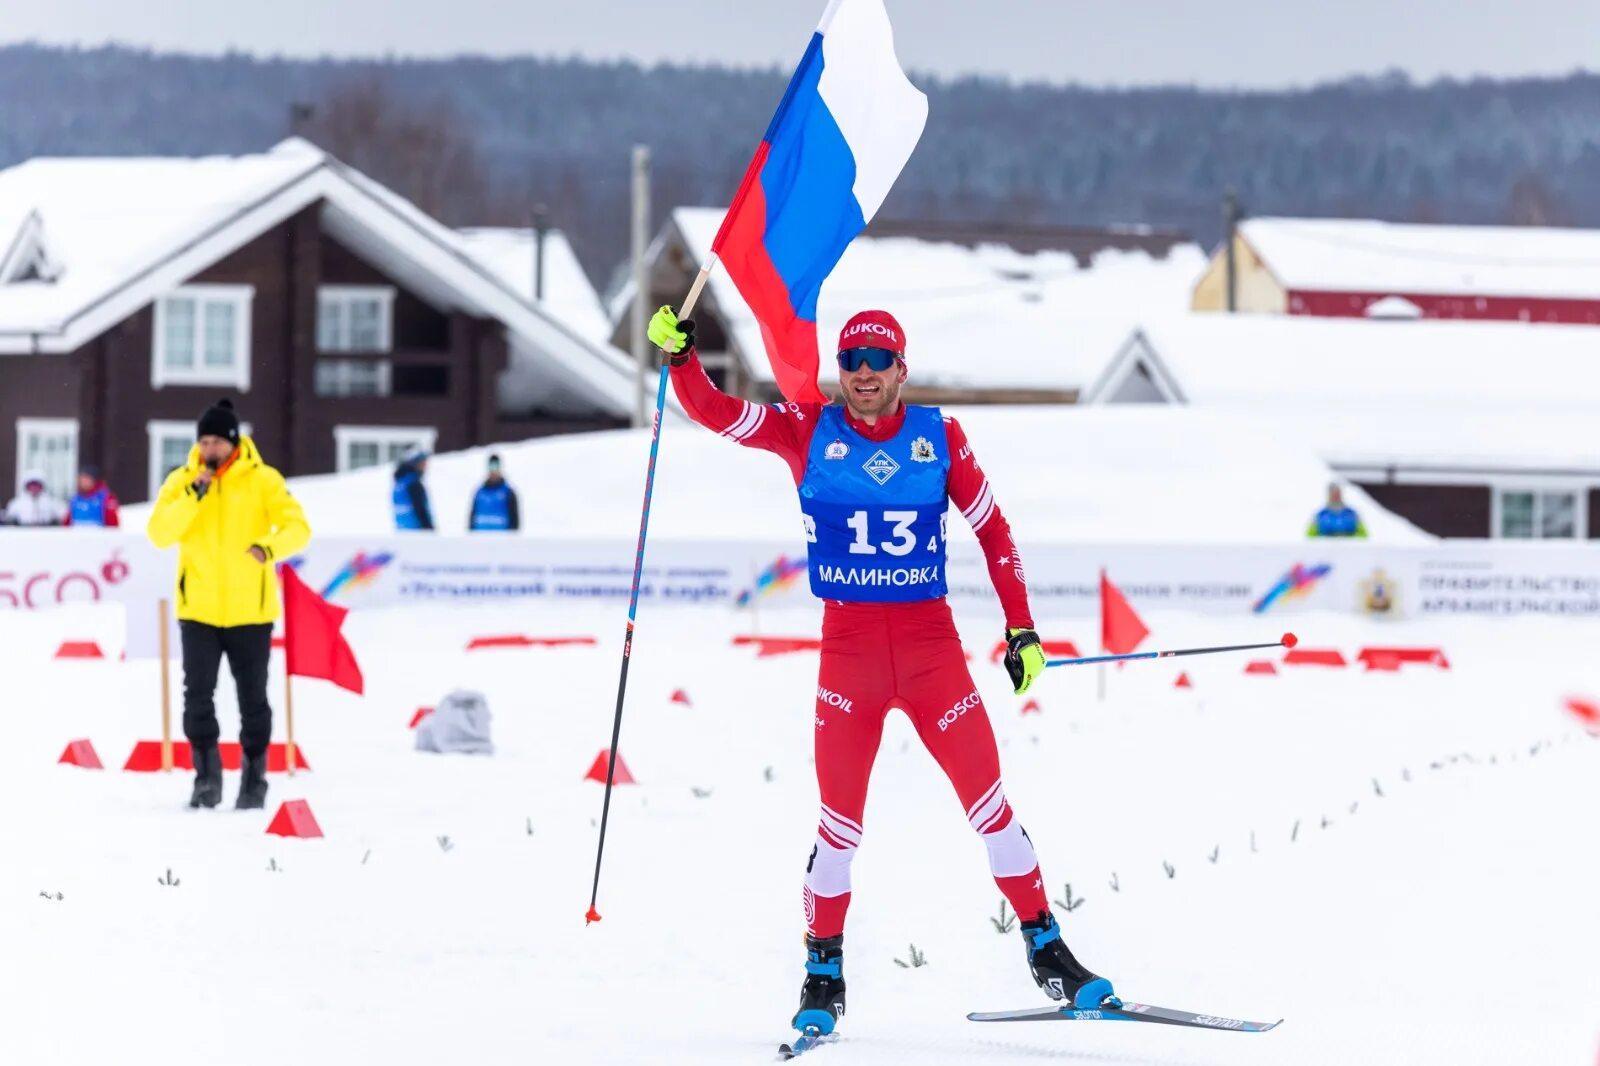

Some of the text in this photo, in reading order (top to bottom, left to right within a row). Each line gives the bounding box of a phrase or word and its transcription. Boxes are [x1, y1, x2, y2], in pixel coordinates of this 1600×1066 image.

[843, 322, 897, 343] LUKOIL
[847, 510, 918, 556] 13
[926, 536, 937, 553] 4
[819, 564, 938, 586] МАЛИНОВКА
[937, 692, 980, 732] BOSCO
